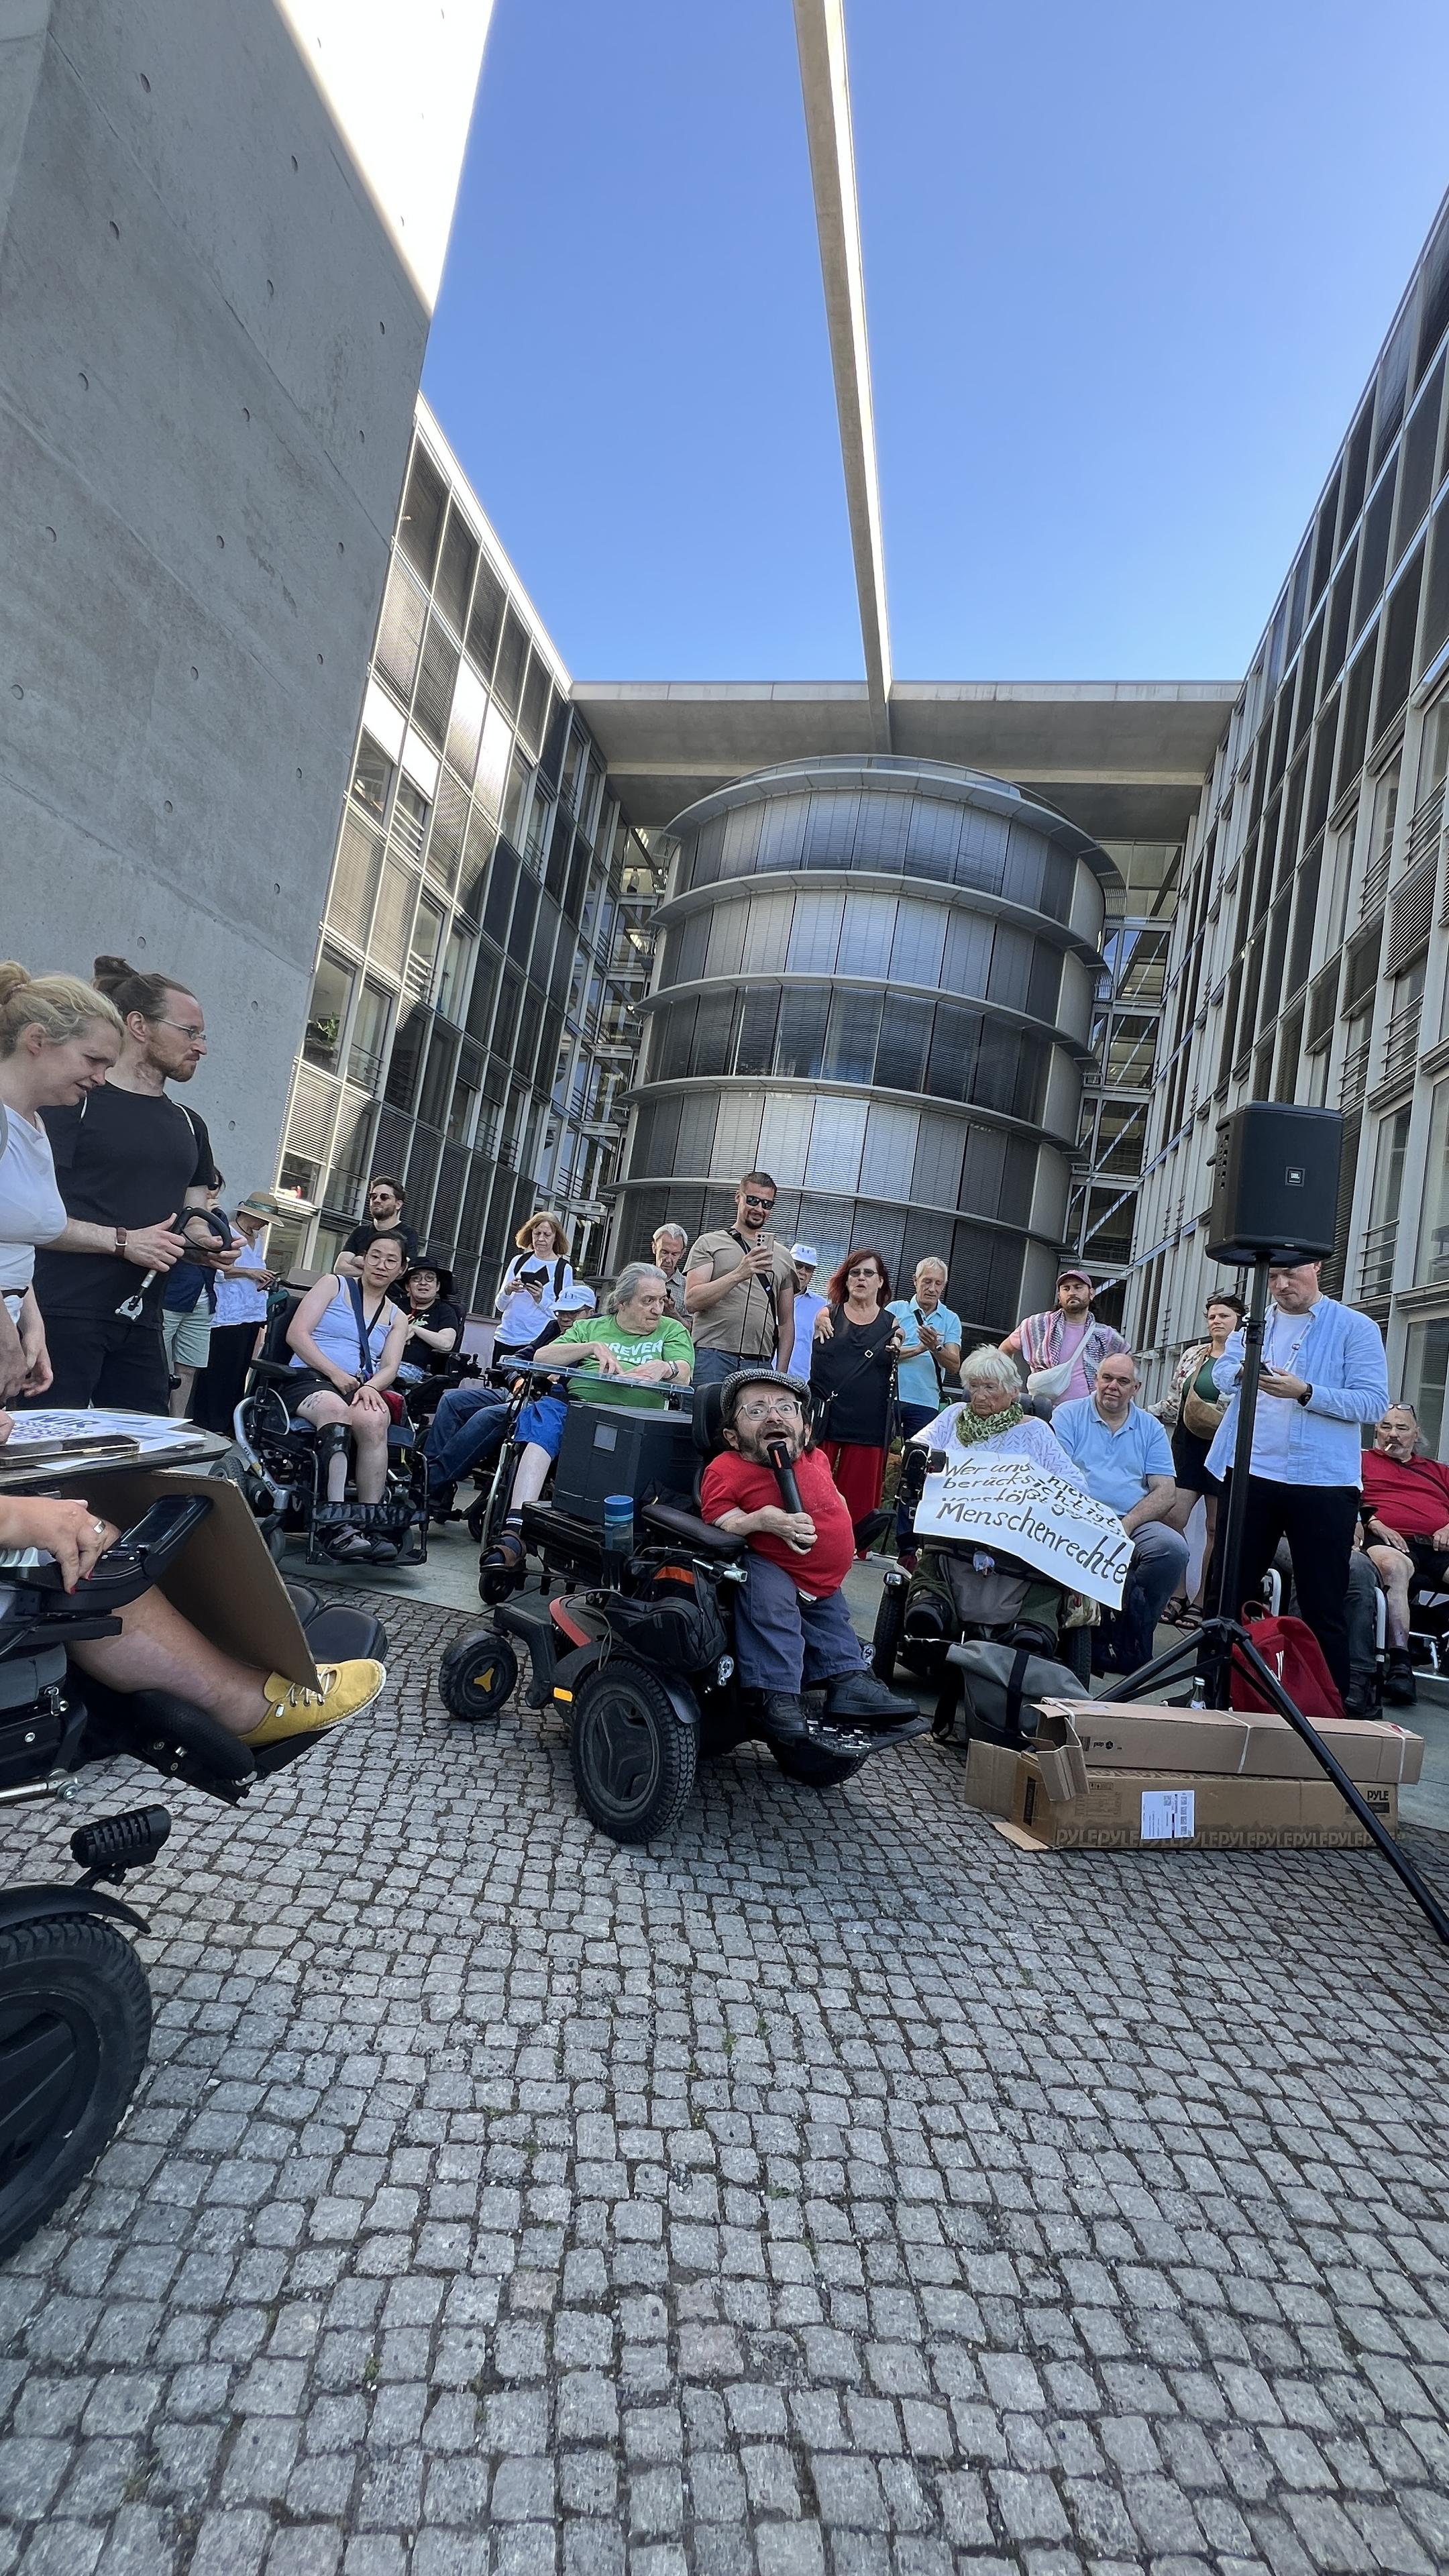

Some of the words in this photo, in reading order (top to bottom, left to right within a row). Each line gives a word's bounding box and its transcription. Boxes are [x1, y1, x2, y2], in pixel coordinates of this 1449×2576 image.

[604, 1340, 663, 1356] REVER
[945, 1457, 987, 1477] Wer
[936, 1503, 1128, 1585] Menschenrechte
[1367, 1790, 1389, 1801] PYLE
